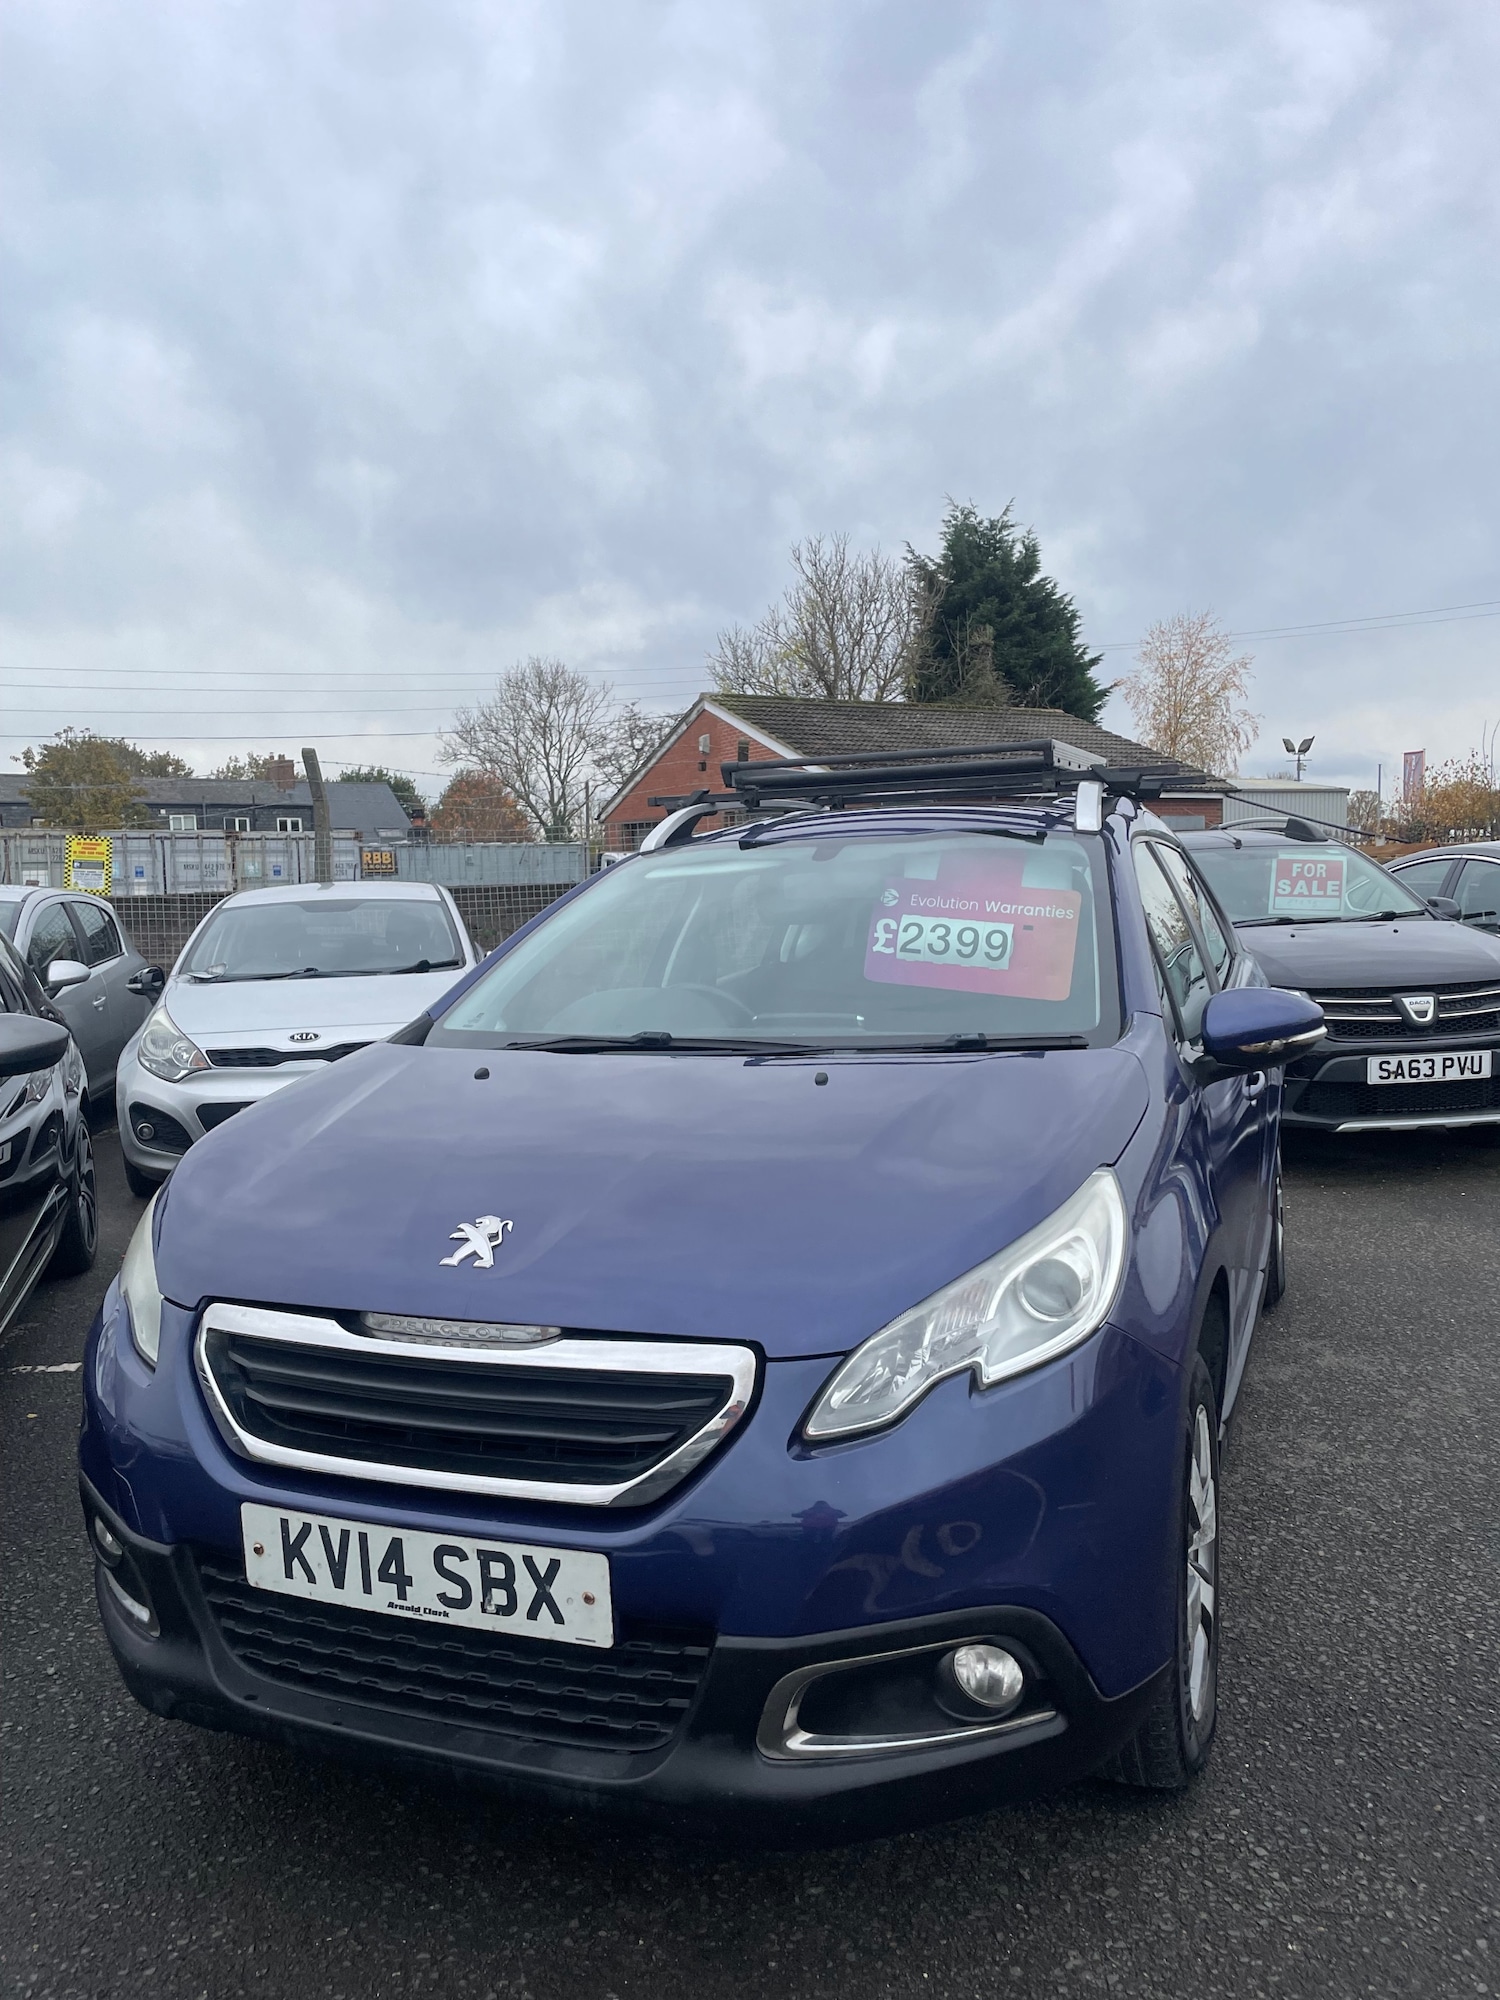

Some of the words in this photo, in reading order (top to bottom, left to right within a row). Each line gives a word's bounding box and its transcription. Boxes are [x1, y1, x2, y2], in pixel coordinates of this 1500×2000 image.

[363, 851, 392, 864] RBB
[1292, 863, 1326, 877] FOR
[1277, 879, 1340, 896] SALE
[910, 894, 979, 911] Evolution
[985, 900, 1074, 919] Warranties
[872, 918, 1009, 962] £2399
[1378, 1058, 1435, 1080] SA63
[1442, 1055, 1482, 1077] PVU
[389, 1318, 506, 1340] PEUGEOT
[280, 1517, 413, 1601] KV14
[433, 1543, 565, 1625] SBX
[387, 1601, 421, 1613] Arnold
[423, 1607, 450, 1618] Clark
